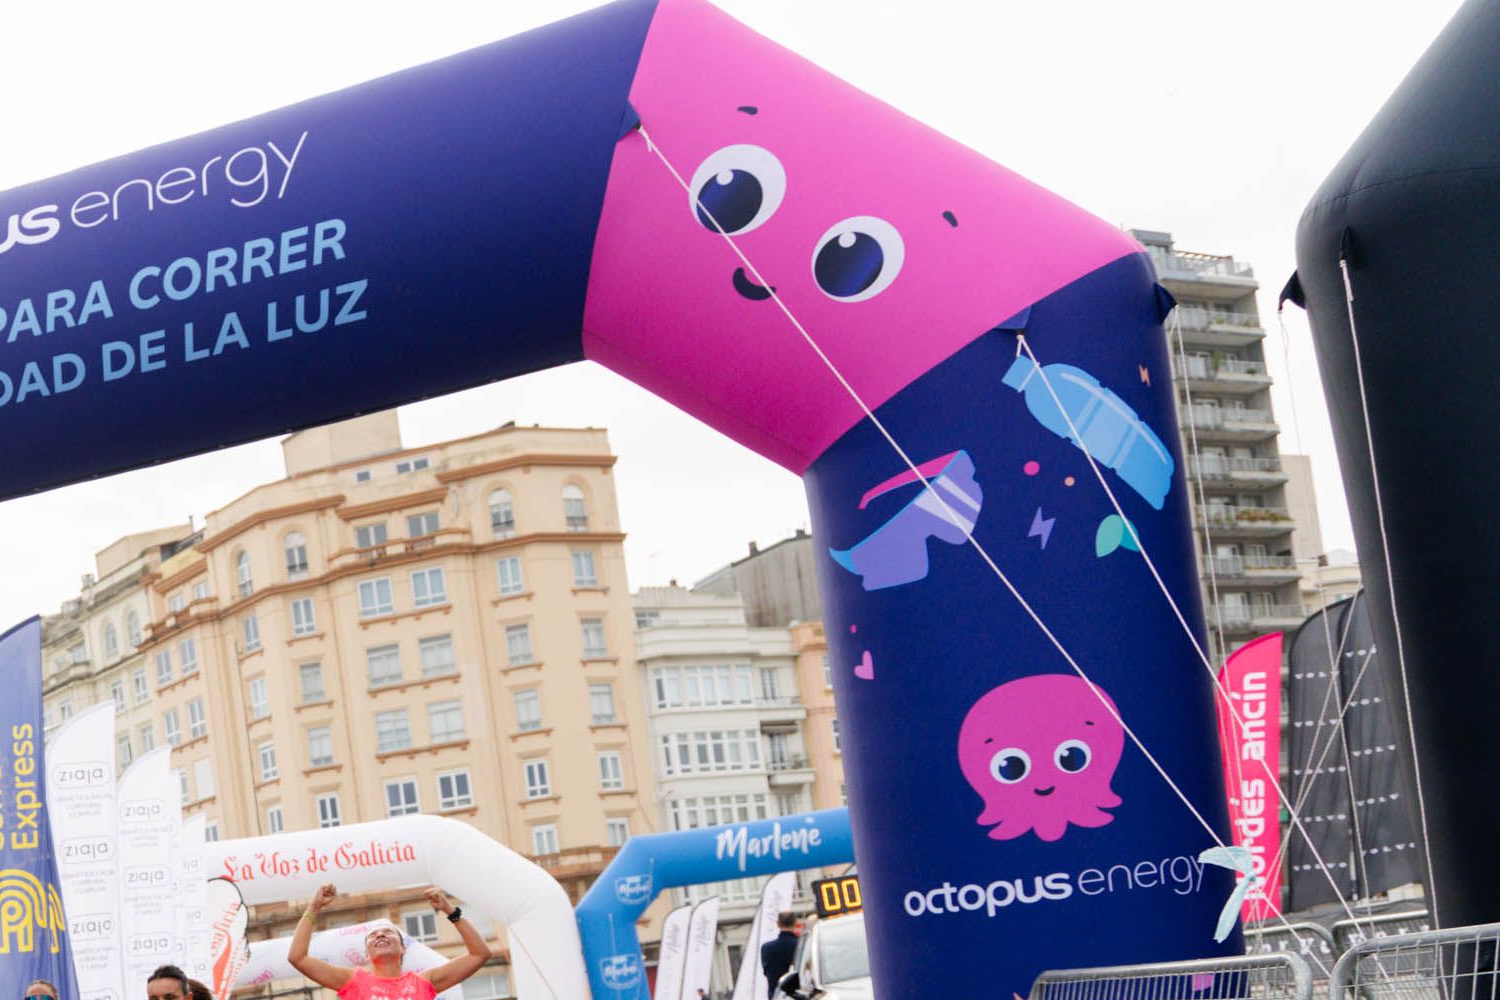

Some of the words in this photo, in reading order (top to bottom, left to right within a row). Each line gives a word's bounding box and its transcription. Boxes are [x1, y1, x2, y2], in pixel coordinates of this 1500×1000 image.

[70, 131, 308, 228] energy
[128, 218, 348, 311] CORRER
[102, 323, 167, 381] DE
[184, 311, 250, 362] LA
[266, 280, 370, 343] LUZ
[1231, 671, 1267, 761] ancín
[12, 723, 40, 851] Express
[222, 855, 255, 882] La
[255, 851, 301, 879] Voz
[307, 848, 329, 873] de
[334, 840, 417, 870] Galicia
[716, 822, 821, 871] Marlene
[904, 872, 1074, 917] octopus
[1077, 855, 1206, 896] energy
